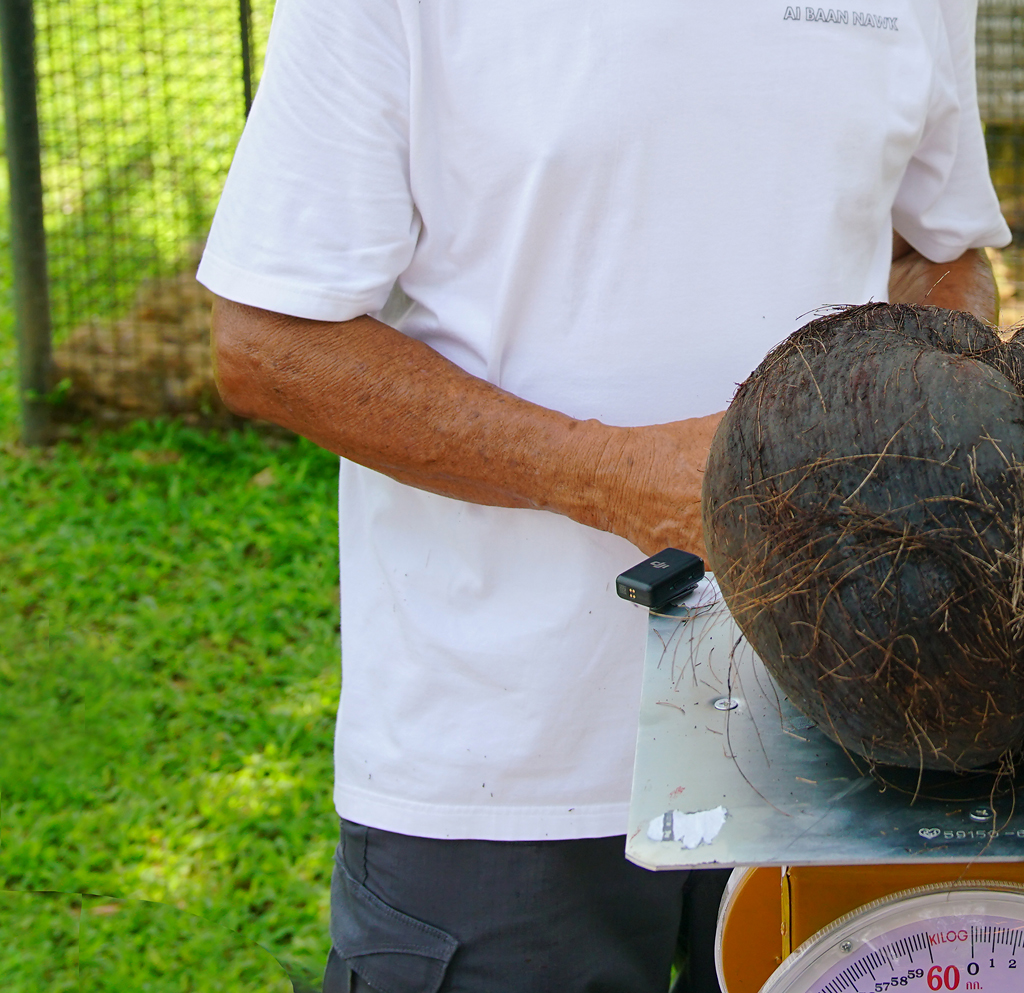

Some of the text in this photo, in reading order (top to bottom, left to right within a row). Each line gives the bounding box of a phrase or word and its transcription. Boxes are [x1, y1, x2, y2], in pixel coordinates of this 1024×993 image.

[783, 6, 898, 31] AI BAAN NAWK
[929, 929, 968, 946] KILOG
[874, 982, 890, 992] 57
[890, 976, 908, 986] 58
[907, 968, 924, 979] 59
[927, 965, 960, 991] 60
[967, 962, 980, 976] 0
[989, 958, 995, 968] 1
[1008, 959, 1017, 969] 2
